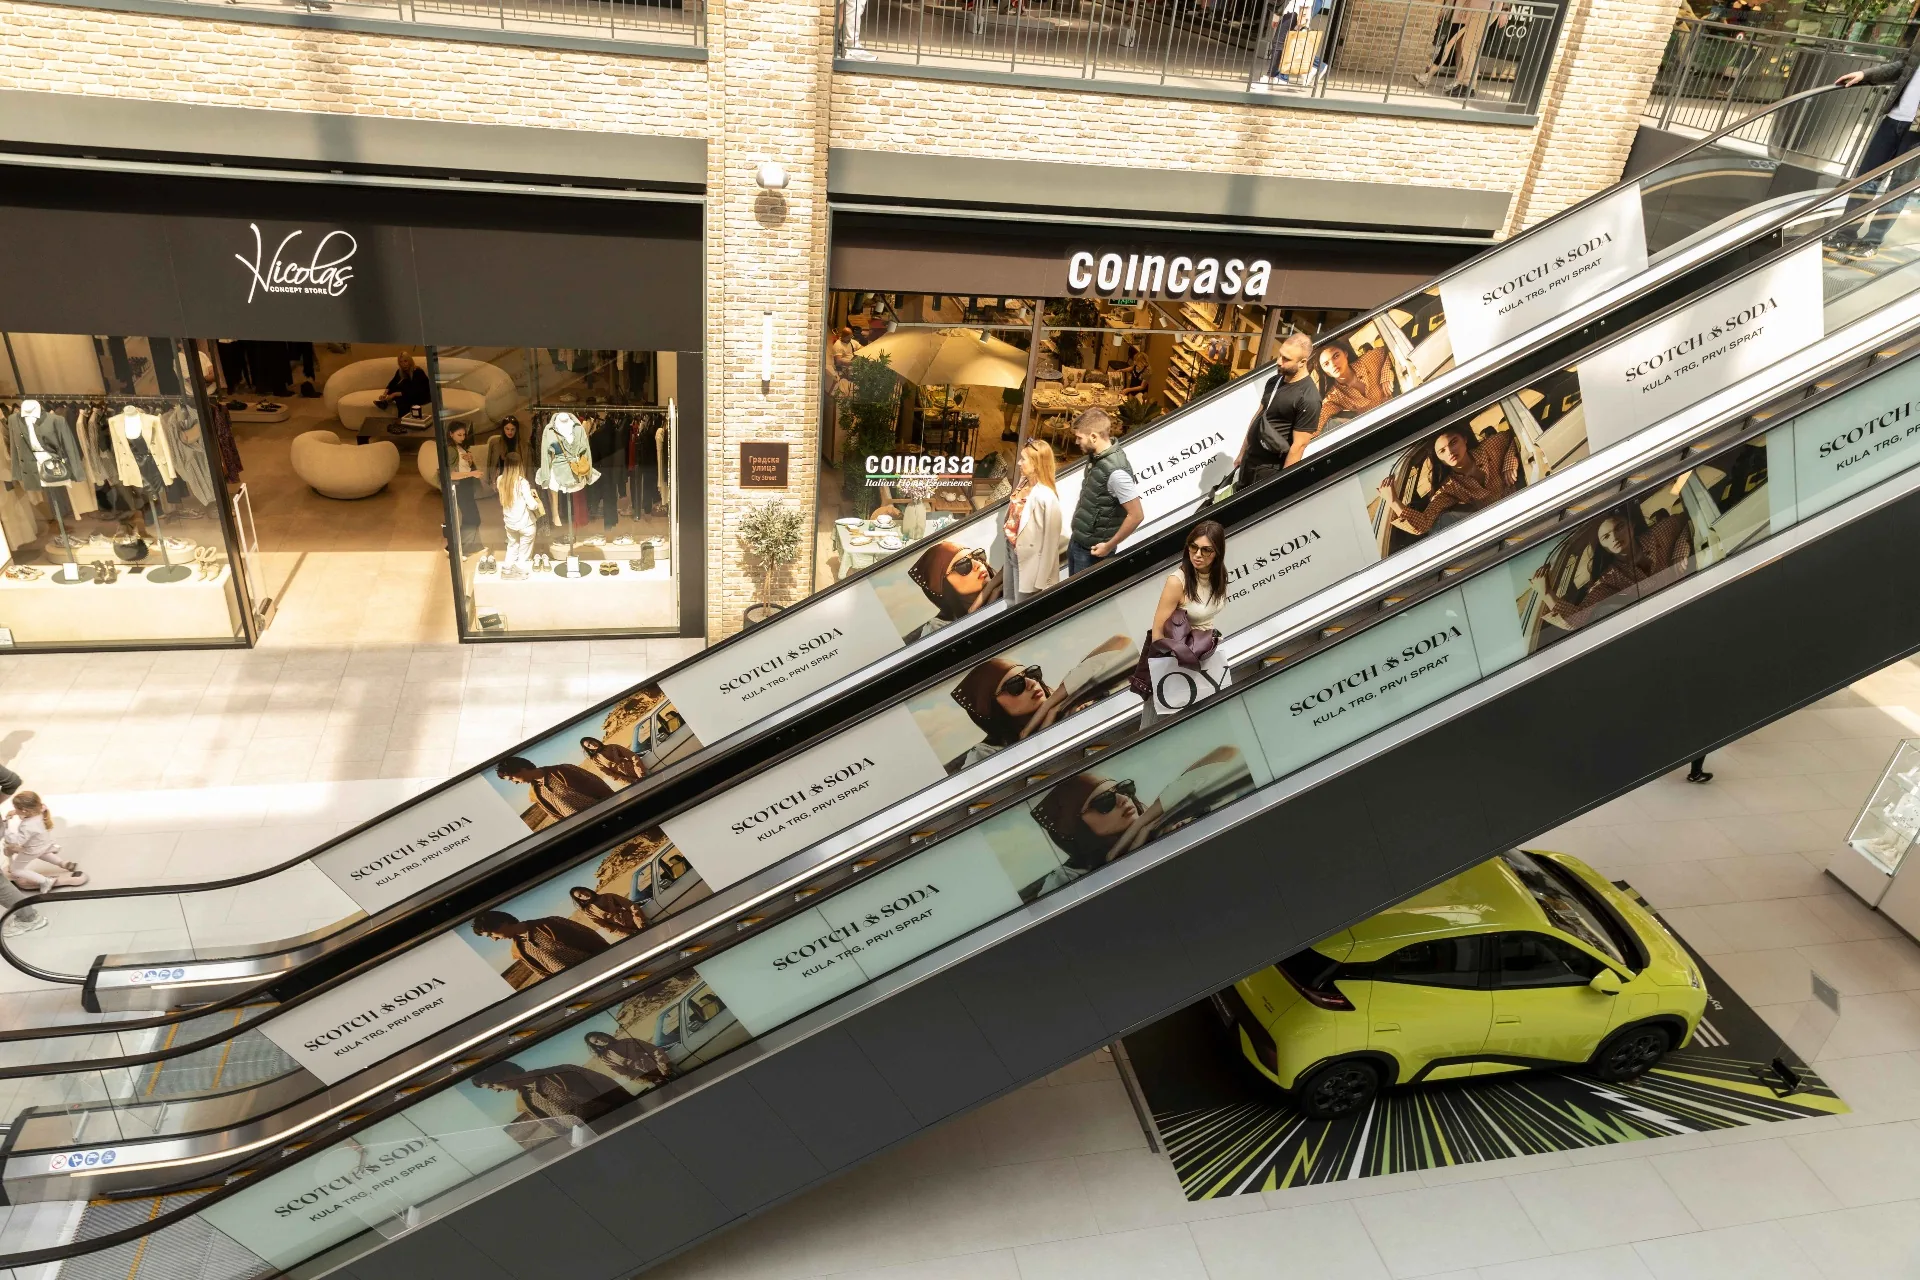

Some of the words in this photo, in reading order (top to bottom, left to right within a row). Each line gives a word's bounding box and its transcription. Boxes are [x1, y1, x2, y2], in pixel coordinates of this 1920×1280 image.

[270, 286, 302, 294] CONCEPT
[304, 287, 328, 295] STORE
[1068, 251, 1272, 296] coincasa
[1483, 263, 1549, 305] SCOTCH
[1552, 256, 1565, 270] &
[1568, 232, 1612, 262] SODA
[1499, 300, 1523, 315] KULA
[1525, 289, 1546, 302] TRG,
[1549, 274, 1569, 289] PRVI
[1573, 258, 1602, 278] SPRAT
[1626, 333, 1703, 382] SCOTCH
[1707, 325, 1722, 341] &
[1726, 297, 1777, 331] SODA
[1642, 375, 1671, 393] KULA
[1674, 361, 1699, 377] TRG,
[1702, 346, 1726, 363] PRVI
[1730, 327, 1763, 349] SPRAT
[1167, 456, 1179, 467] &
[1180, 432, 1225, 460] SODA
[1820, 402, 1910, 458] SCOTCH
[1837, 450, 1870, 471] KULA
[1874, 435, 1902, 451] TRG,
[748, 455, 780, 465] Градска
[750, 474, 761, 482] City
[751, 465, 777, 473] улица
[865, 455, 975, 474] coincasa
[865, 478, 895, 487] Italian
[1167, 472, 1187, 486] PRVI
[1189, 455, 1218, 474] SPRAT
[1253, 557, 1267, 570] &
[1270, 529, 1320, 561] SODA
[1226, 589, 1250, 602] TRG,
[1252, 574, 1276, 590] PRVI
[1278, 555, 1311, 576] SPRAT
[720, 656, 784, 694] SCOTCH
[786, 650, 798, 661] &
[799, 628, 843, 654] SODA
[741, 687, 766, 701] KULA
[766, 676, 788, 688] TRG,
[789, 664, 809, 677] PRVI
[811, 649, 838, 666] SPRAT
[1290, 665, 1378, 716] SCOTCH
[1382, 656, 1399, 672] &
[1402, 626, 1462, 661] SODA
[1313, 706, 1346, 726] KULA
[1348, 692, 1377, 708] TRG,
[1380, 675, 1407, 693] PRVI
[1411, 655, 1449, 679] SPRAT
[732, 791, 806, 834] SCOTCH
[809, 784, 823, 796] &
[824, 758, 875, 787] SODA
[757, 825, 786, 841] KULA
[786, 812, 811, 825] TRG,
[812, 798, 836, 814] PRVI
[838, 781, 870, 800] SPRAT
[351, 844, 415, 880] SCOTCH
[416, 838, 429, 848] &
[428, 816, 473, 842] SODA
[376, 873, 401, 886] KULA
[422, 851, 443, 863] PRVI
[443, 835, 471, 852] SPRAT
[773, 922, 860, 971] SCOTCH
[863, 914, 880, 927] &
[881, 884, 940, 917] SODA
[802, 959, 835, 977] KULA
[836, 945, 865, 960] TRG,
[866, 930, 893, 946] PRVI
[896, 909, 933, 931] SPRAT
[304, 1010, 379, 1052] SCOTCH
[380, 1003, 396, 1014] &
[394, 978, 446, 1006] SODA
[334, 1041, 363, 1056] KULA
[387, 1015, 411, 1030] PRVI
[412, 998, 444, 1017] SPRAT
[309, 1204, 344, 1222] KULA
[372, 1175, 400, 1192] PRVI
[400, 1156, 438, 1177] SPRAT
